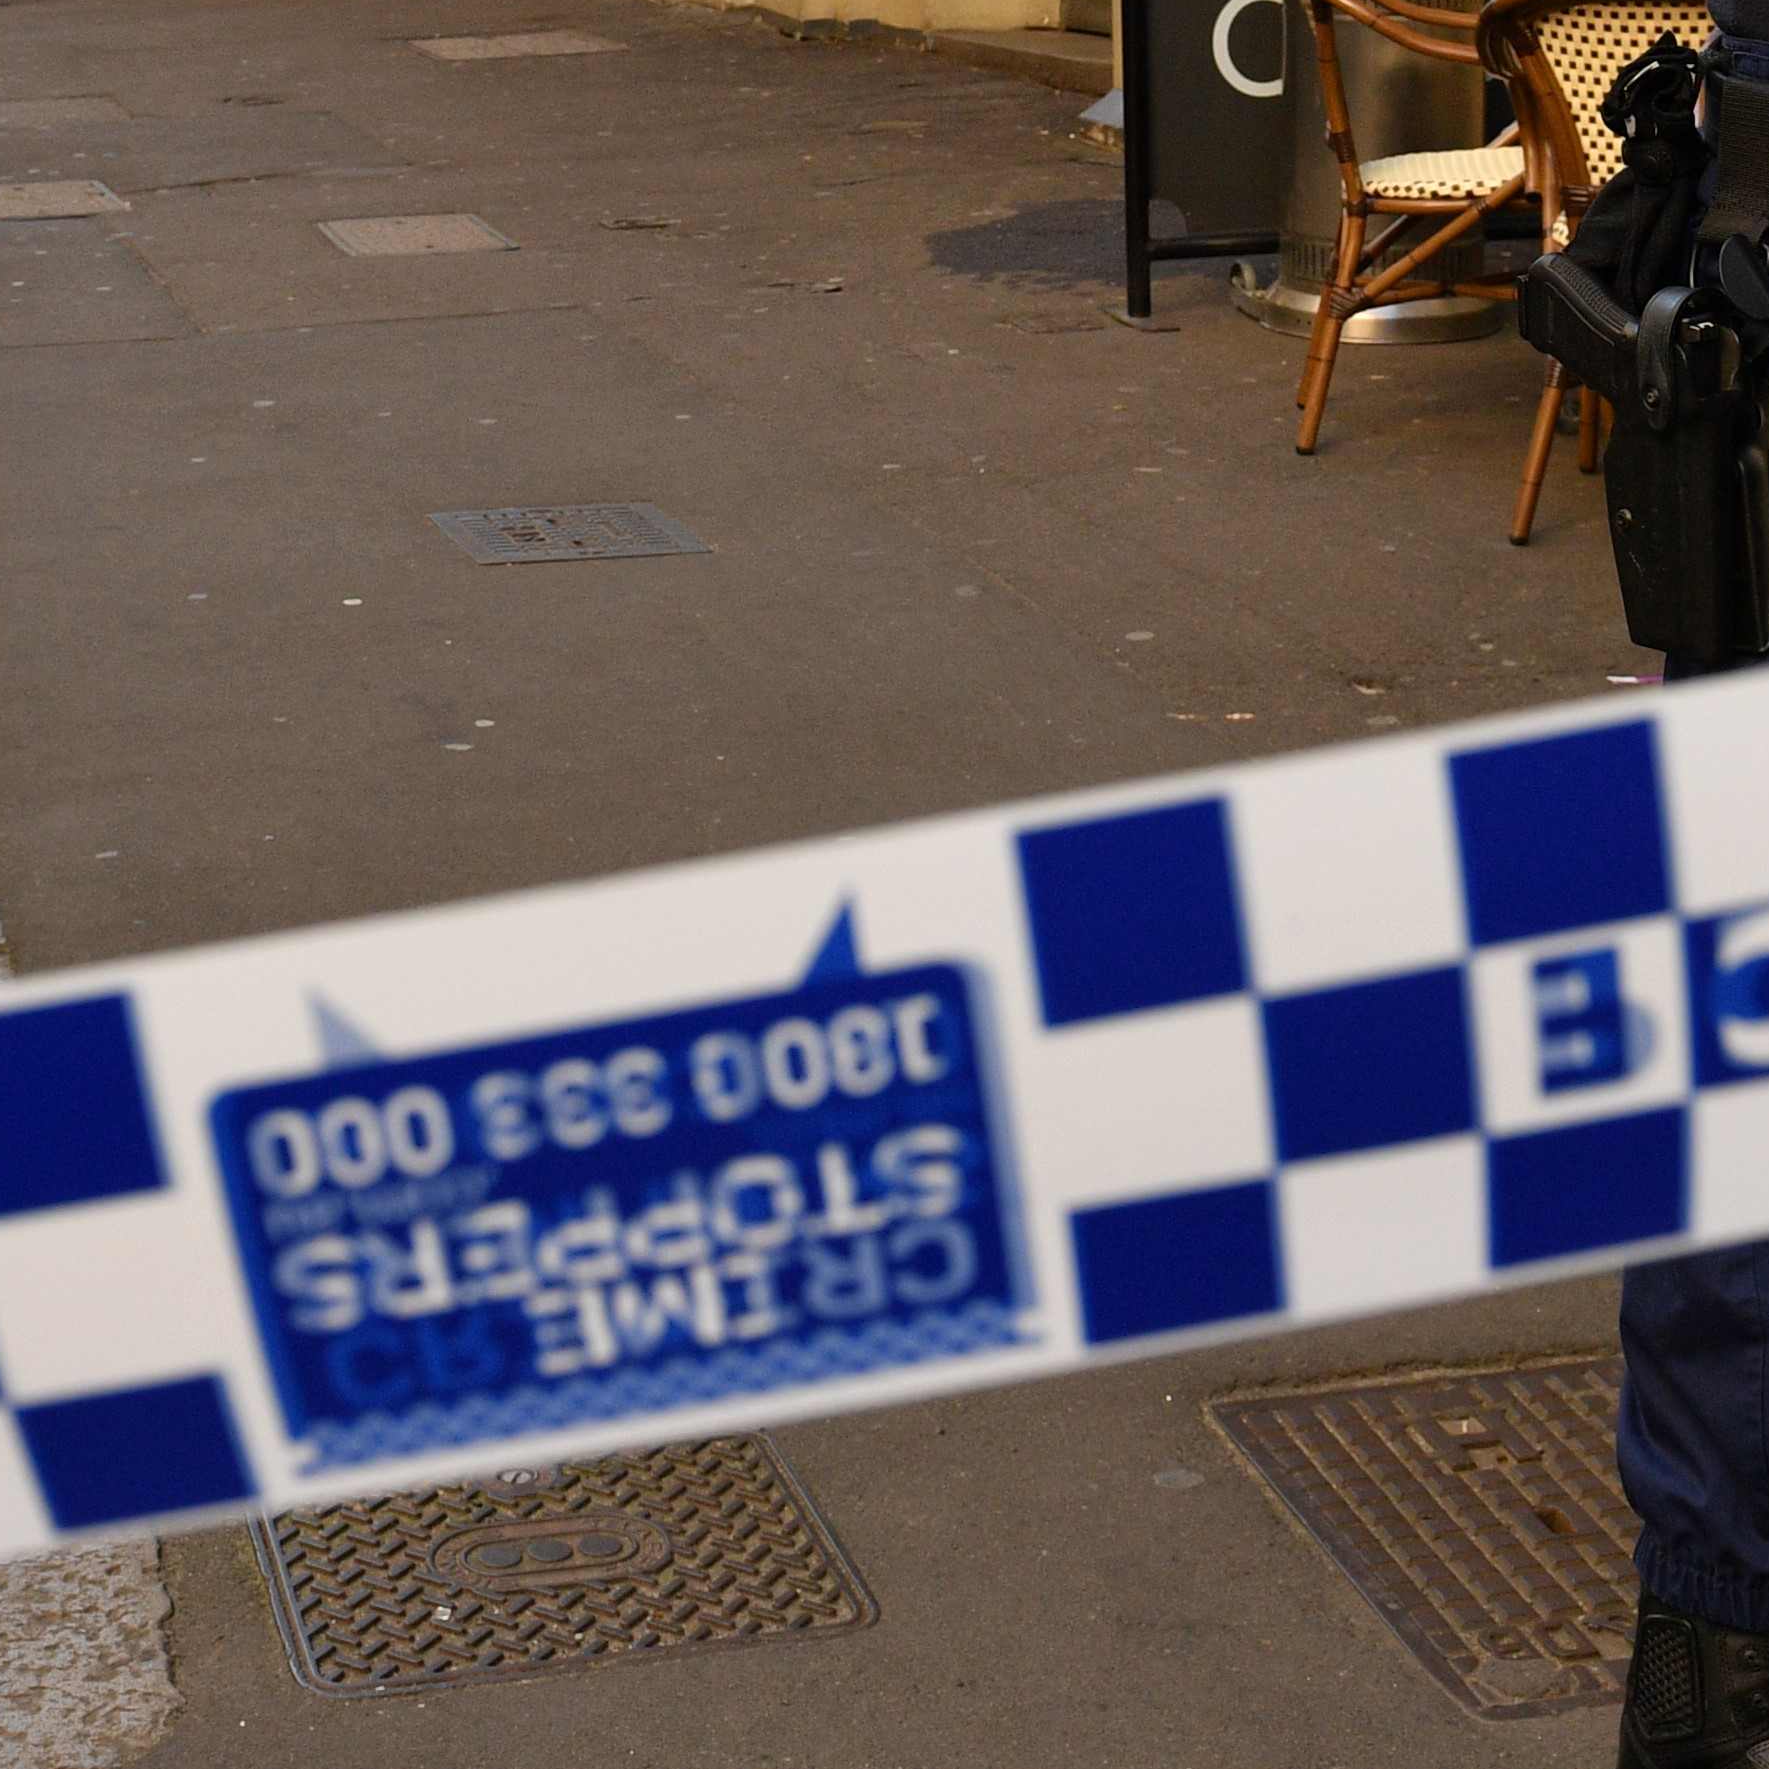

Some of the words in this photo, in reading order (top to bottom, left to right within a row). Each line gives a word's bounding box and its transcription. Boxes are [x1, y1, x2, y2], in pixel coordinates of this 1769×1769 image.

[475, 1047, 672, 1157] 333
[689, 992, 949, 1121] 1800
[251, 1087, 454, 1198] 000
[276, 1125, 969, 1332] STOPPERS
[530, 1217, 982, 1377] CRIME
